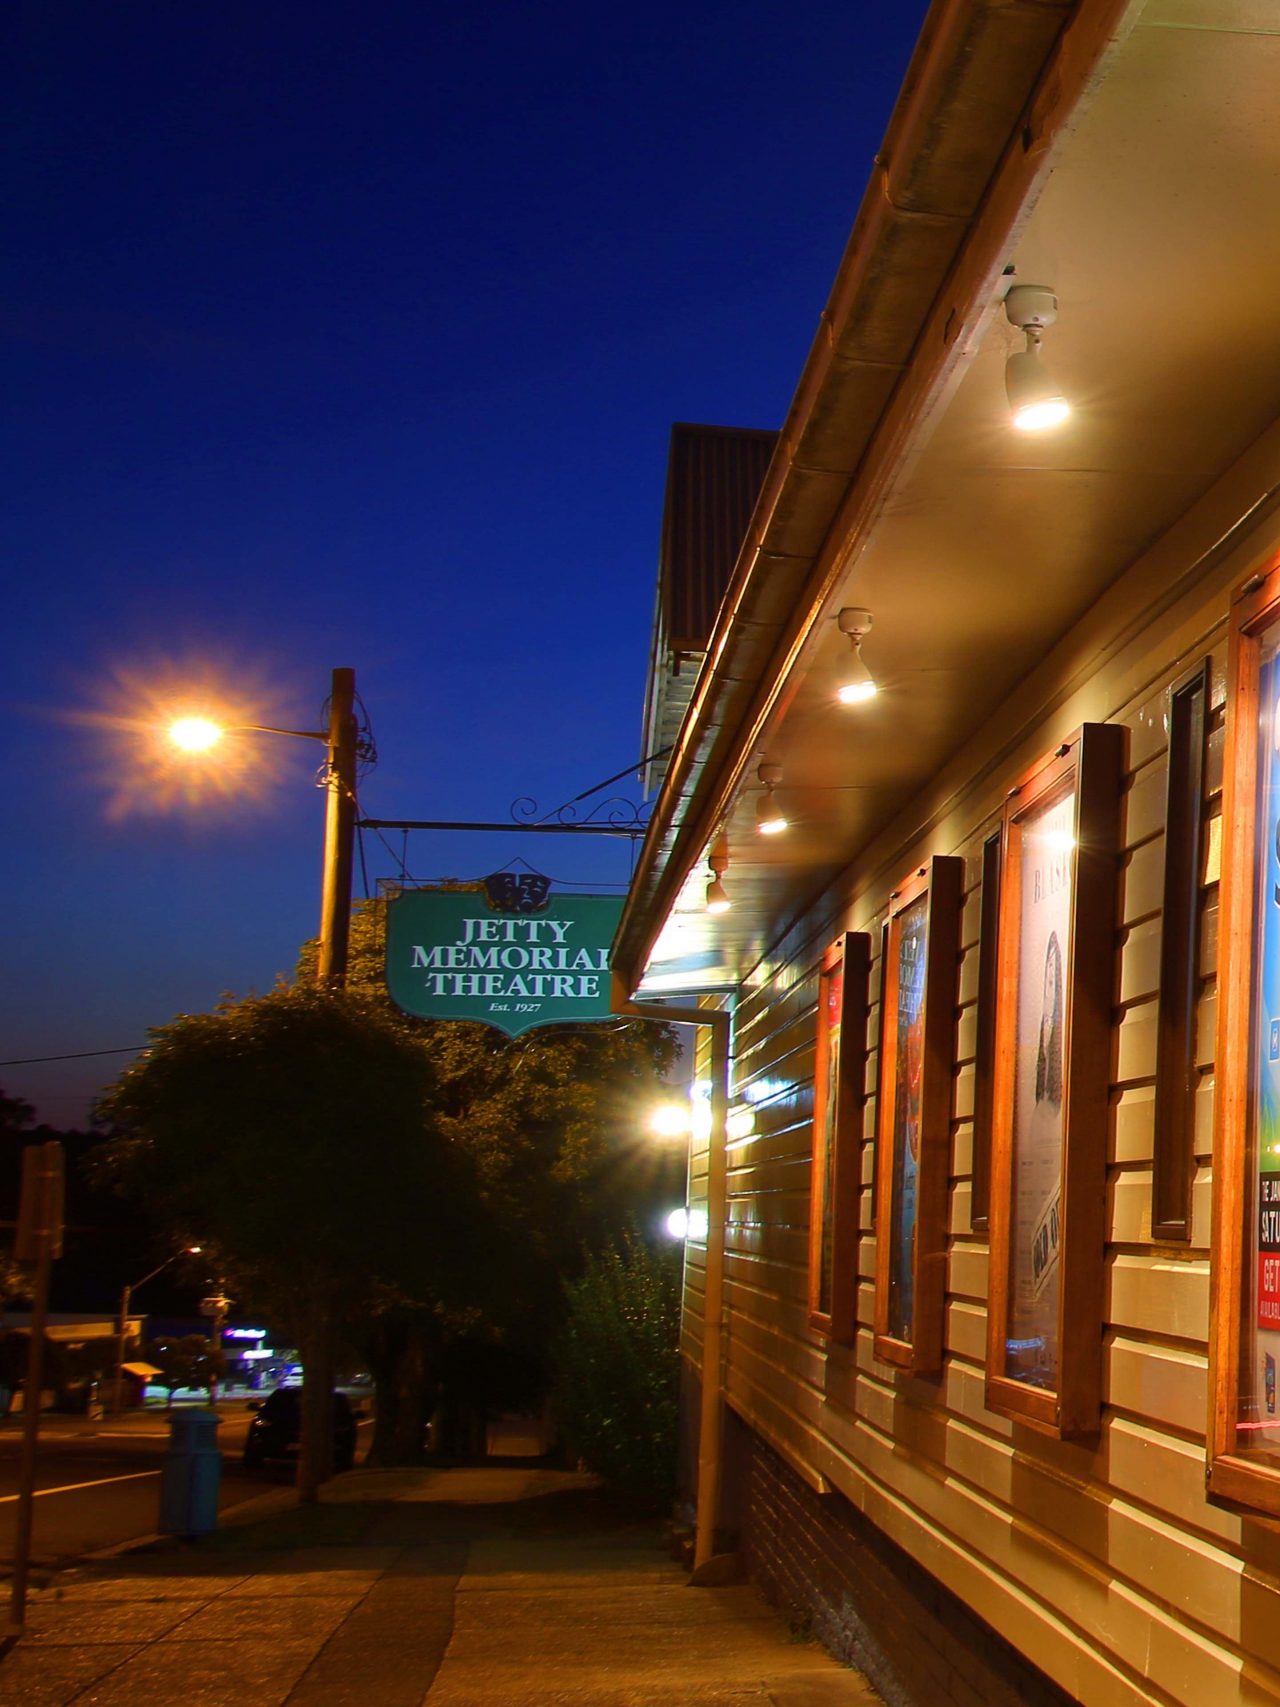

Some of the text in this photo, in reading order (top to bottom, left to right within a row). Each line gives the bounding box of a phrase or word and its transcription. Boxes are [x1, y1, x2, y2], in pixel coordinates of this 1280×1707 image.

[456, 918, 574, 946] JETTY
[425, 972, 600, 998] THEATRE
[489, 1002, 541, 1013] Est. 1927
[1264, 1259, 1280, 1293] GET
